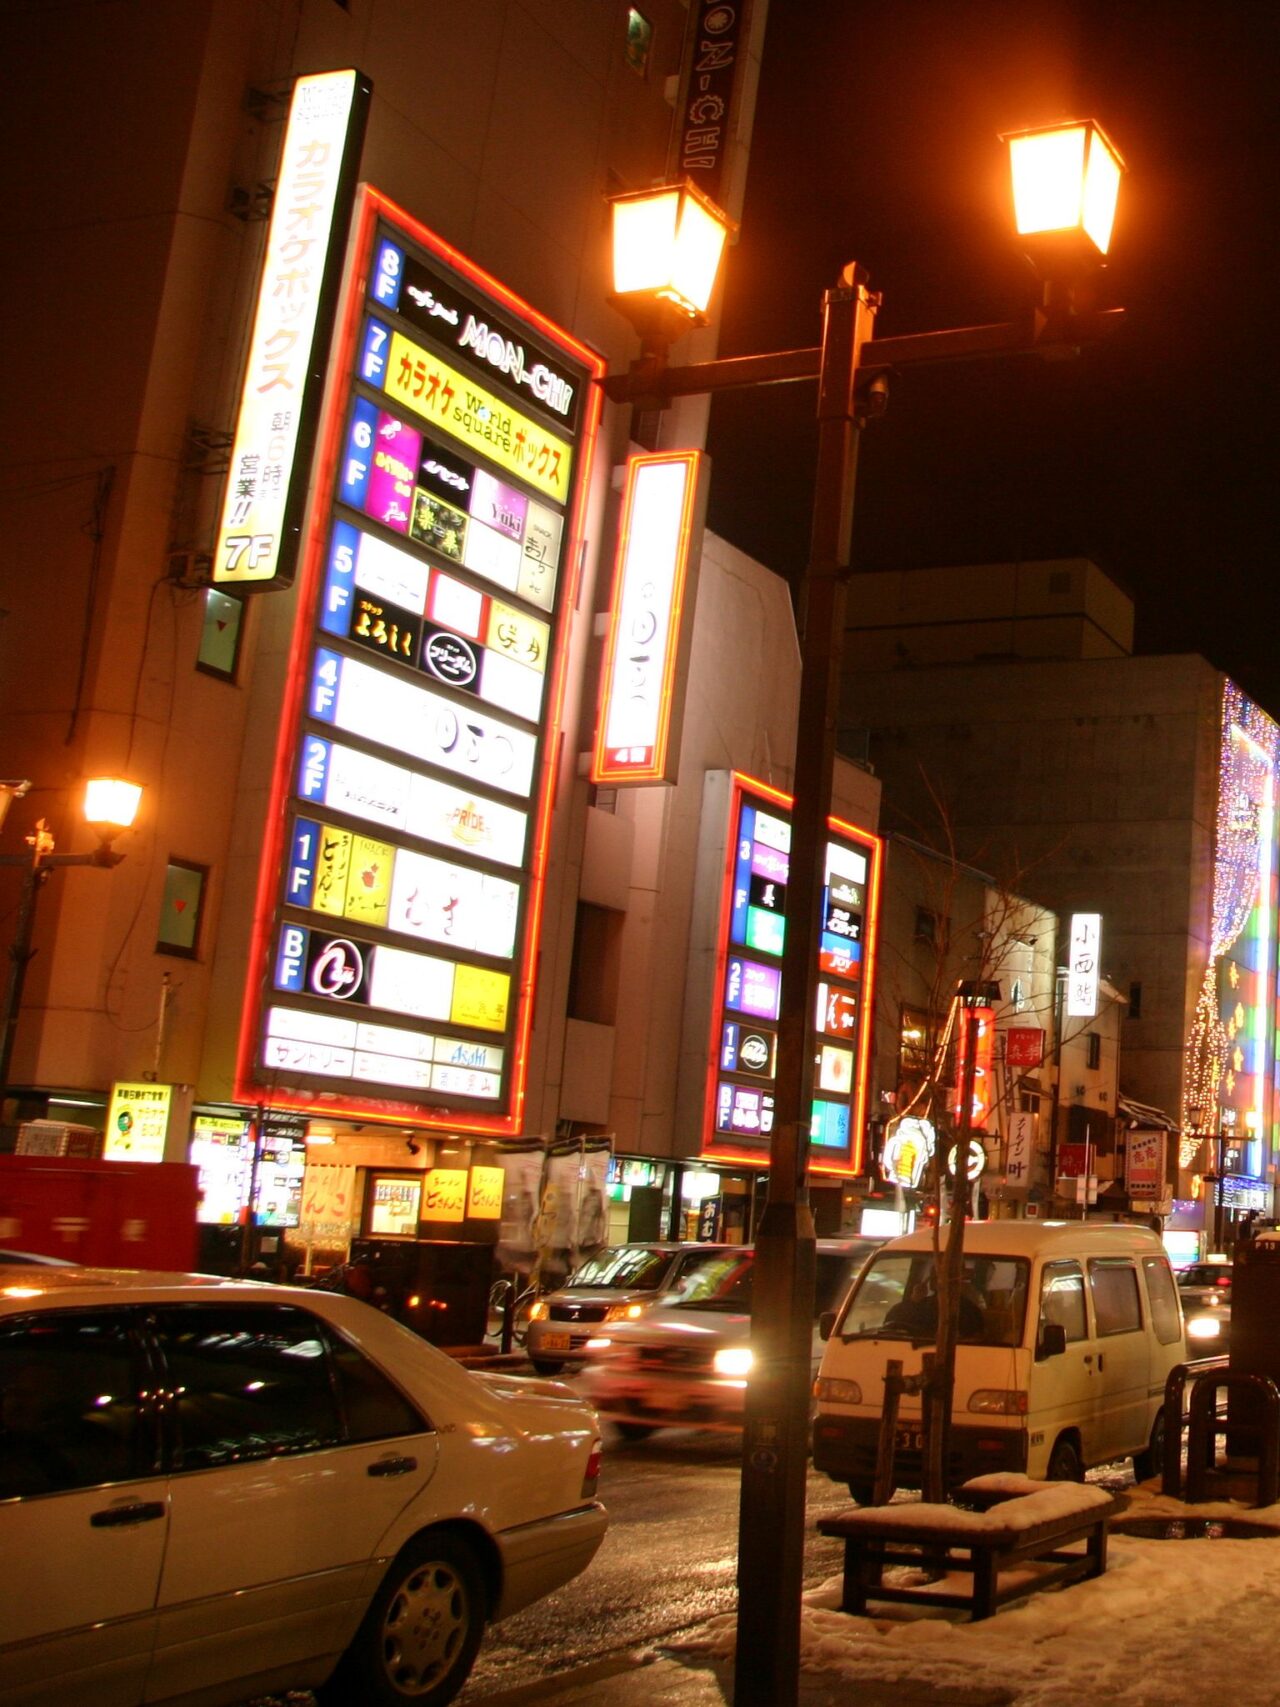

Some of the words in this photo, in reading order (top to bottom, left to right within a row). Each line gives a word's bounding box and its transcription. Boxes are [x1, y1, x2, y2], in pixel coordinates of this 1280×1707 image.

[683, 0, 736, 168] ON-CHI
[256, 138, 331, 396] カラオケボックス
[377, 248, 399, 300] 8F
[363, 326, 388, 379] 7F
[396, 352, 455, 413] カラオケ
[453, 406, 512, 453] square
[465, 390, 512, 436] World
[346, 421, 372, 486] 6F
[512, 428, 562, 486] ボックス
[491, 502, 522, 533] Yuki
[224, 534, 274, 572] 7F
[329, 546, 353, 613] 5F
[352, 612, 412, 658] よろしく
[315, 659, 337, 713] 4F
[303, 744, 327, 796] 2F
[452, 808, 485, 833] PRIDE
[275, 1044, 346, 1069] サントリー
[450, 1043, 488, 1067] Asahi
[701, 1201, 717, 1243] おむ
